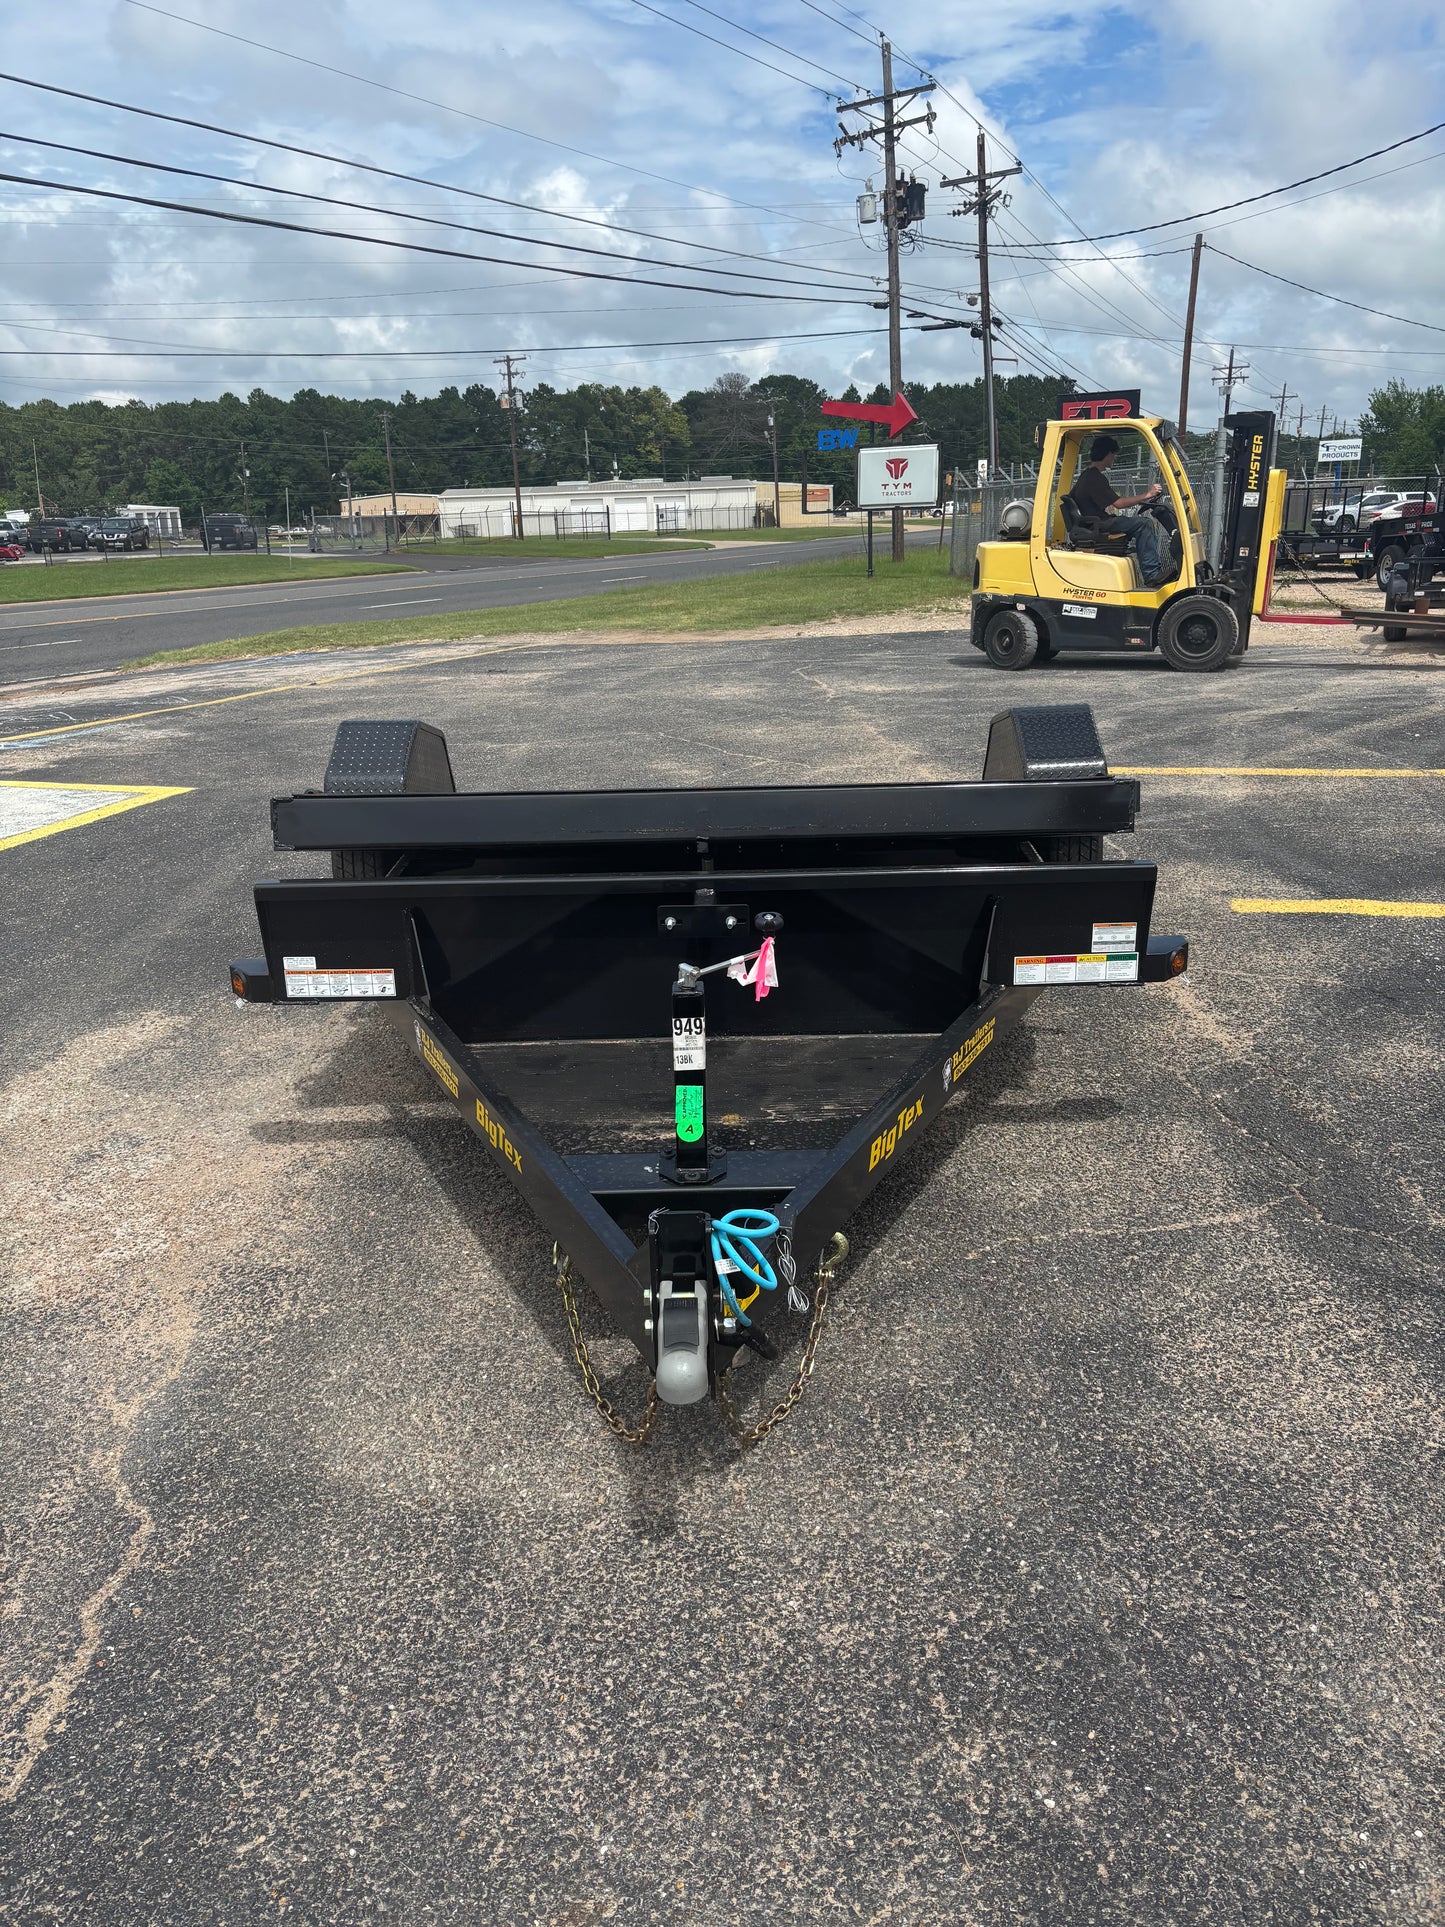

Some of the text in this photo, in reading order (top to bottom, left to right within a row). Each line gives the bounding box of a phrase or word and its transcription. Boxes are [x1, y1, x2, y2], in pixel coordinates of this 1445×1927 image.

[1321, 451, 1359, 459] PRODUCTS
[1247, 434, 1264, 490] HYSTER
[881, 482, 912, 490] TYM
[1421, 520, 1433, 528] PRIDE
[1062, 587, 1095, 597] HYSTER
[673, 1018, 705, 1036] 949
[685, 1124, 694, 1134] A
[868, 1094, 925, 1173] BigTex
[475, 1097, 523, 1175] BigTex
